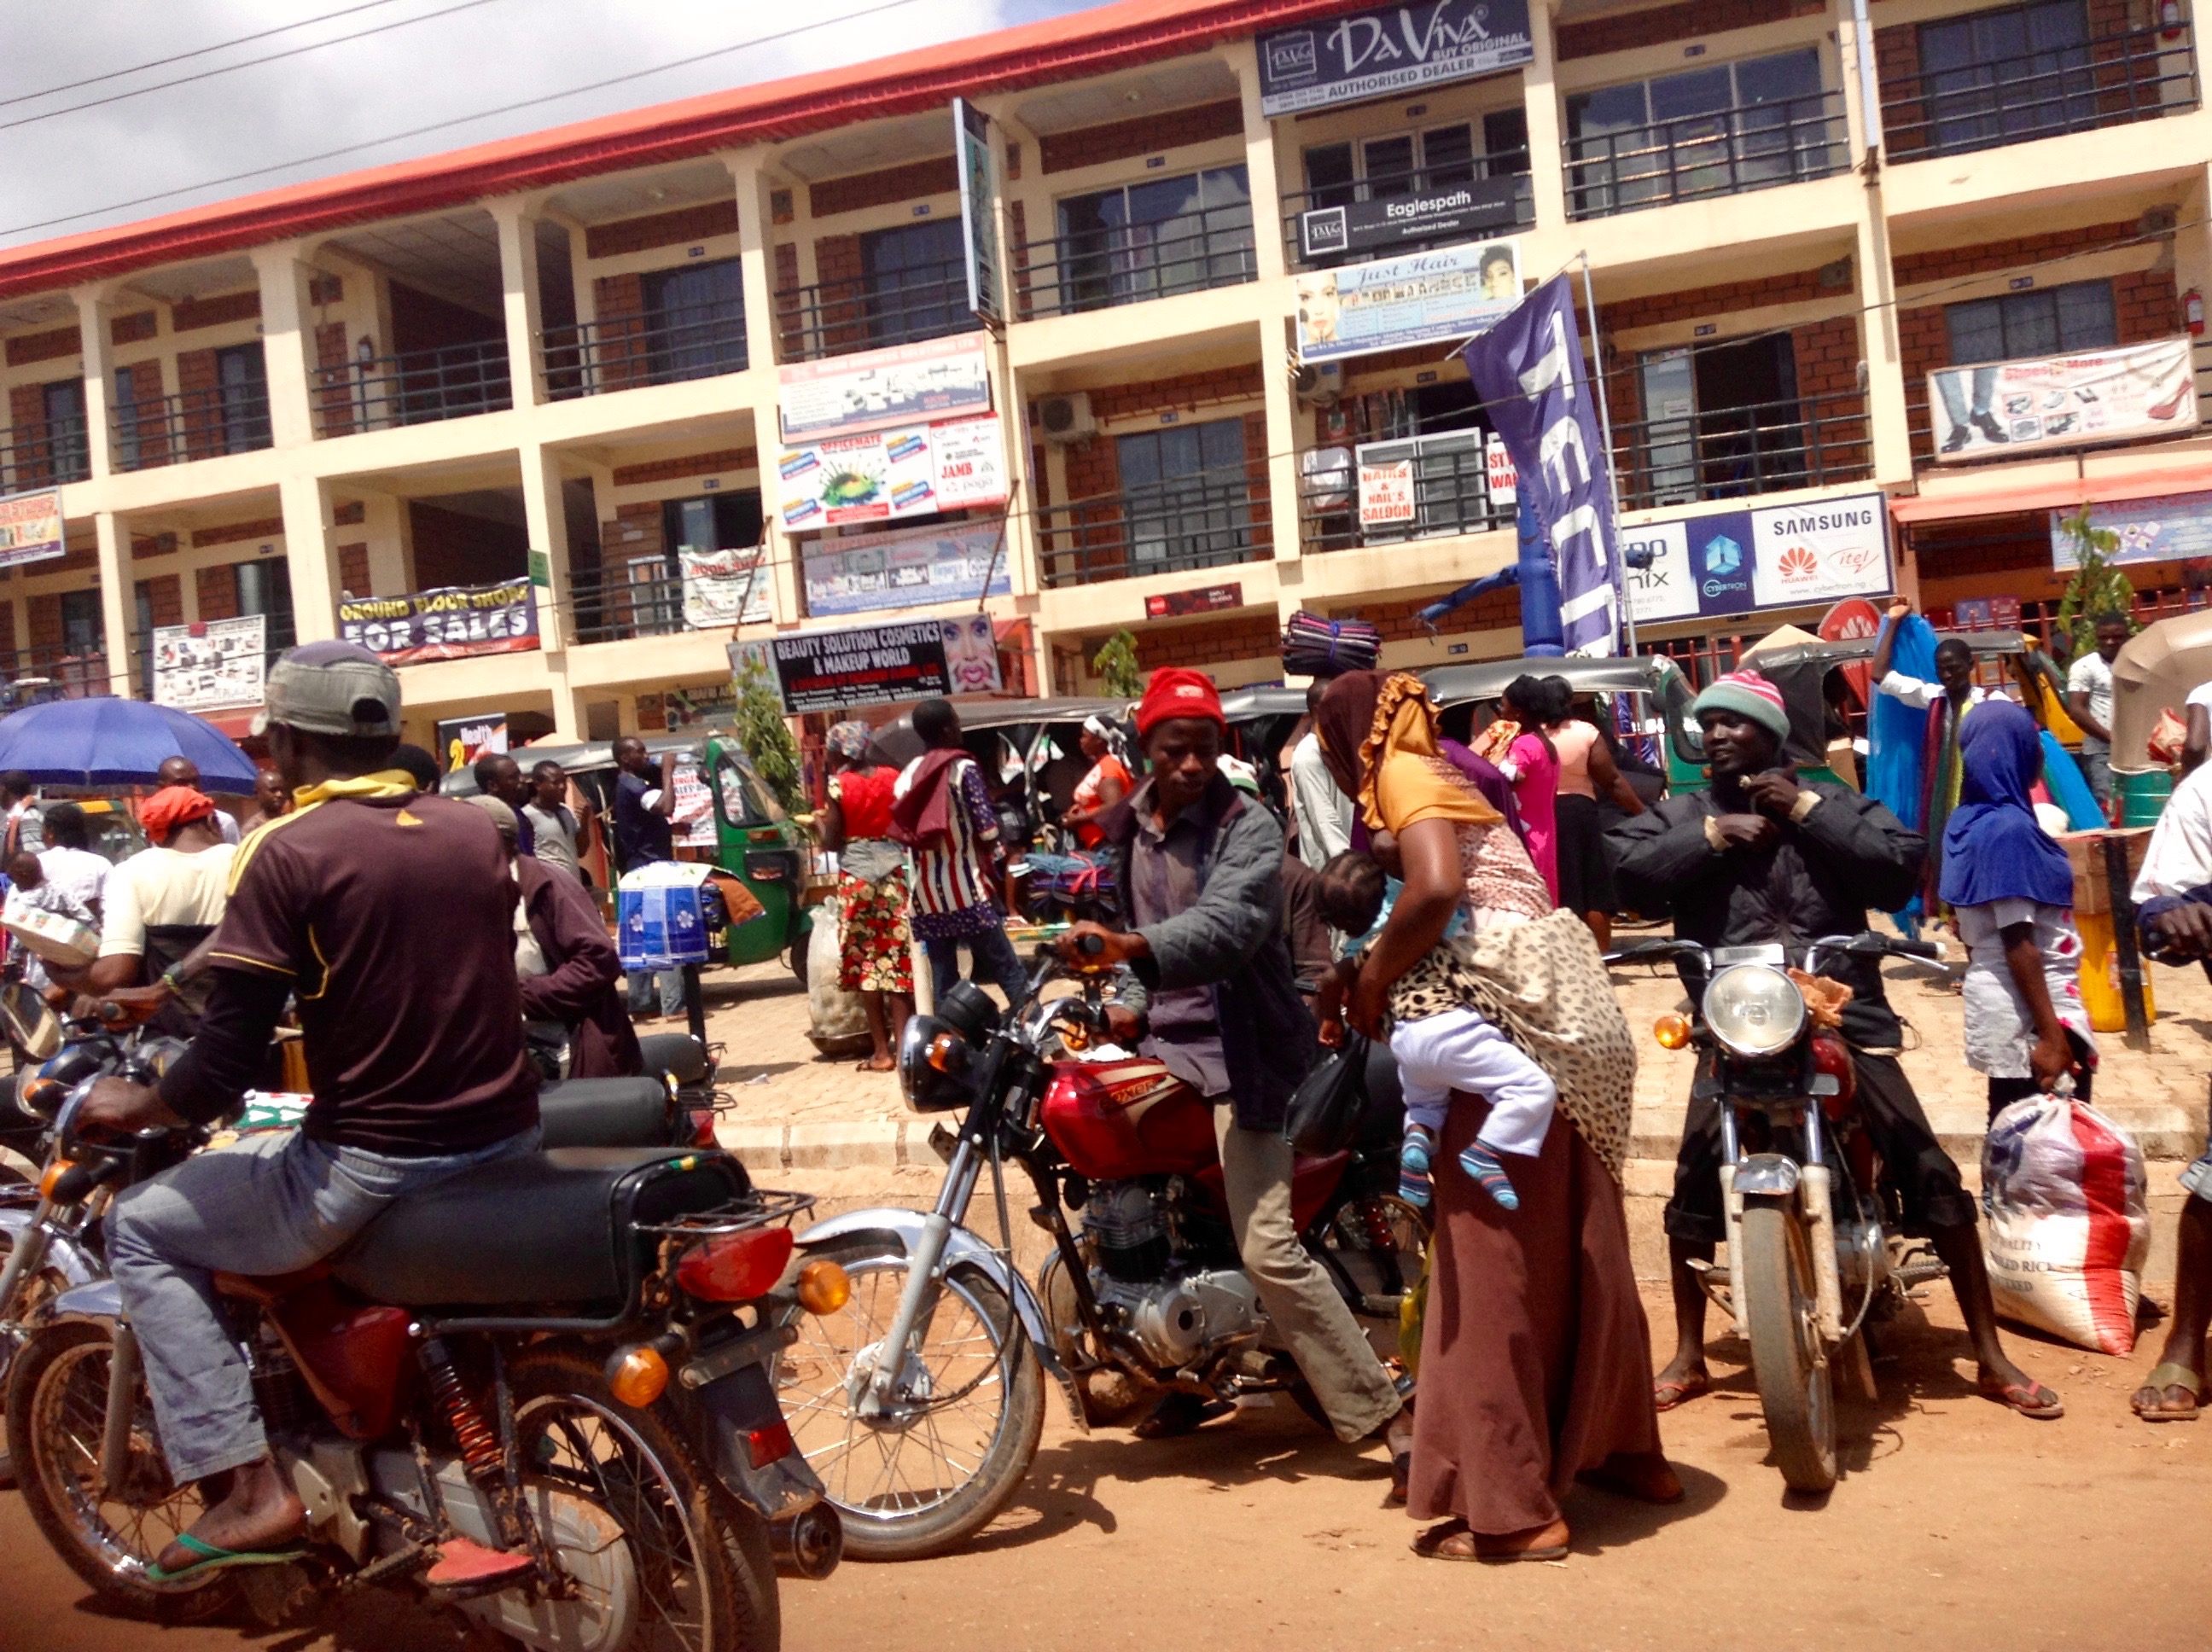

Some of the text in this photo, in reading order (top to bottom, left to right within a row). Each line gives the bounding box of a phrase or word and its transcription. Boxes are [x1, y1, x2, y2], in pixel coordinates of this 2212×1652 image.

[1432, 47, 1460, 62] BUY
[1462, 32, 1527, 55] ORIGINAL
[1329, 70, 1418, 99] AUTHORISED
[1422, 58, 1475, 79] DEALER
[1387, 190, 1471, 218] Eaglespath
[1357, 254, 1459, 285] Just Hair
[941, 462, 973, 480] JAMB
[1362, 503, 1412, 522] SALOON
[1773, 509, 1871, 537] SAMSUNG
[1839, 549, 1870, 567] itel
[1780, 574, 1819, 585] HUAWEI
[340, 585, 528, 622] GROUND FLOOR SHOPS
[345, 620, 414, 652] FOR
[423, 608, 529, 644] SALES
[777, 621, 940, 661] BEAUTY SOLUTION COSMETICS
[814, 646, 911, 676] & MAKEUP WORLD
